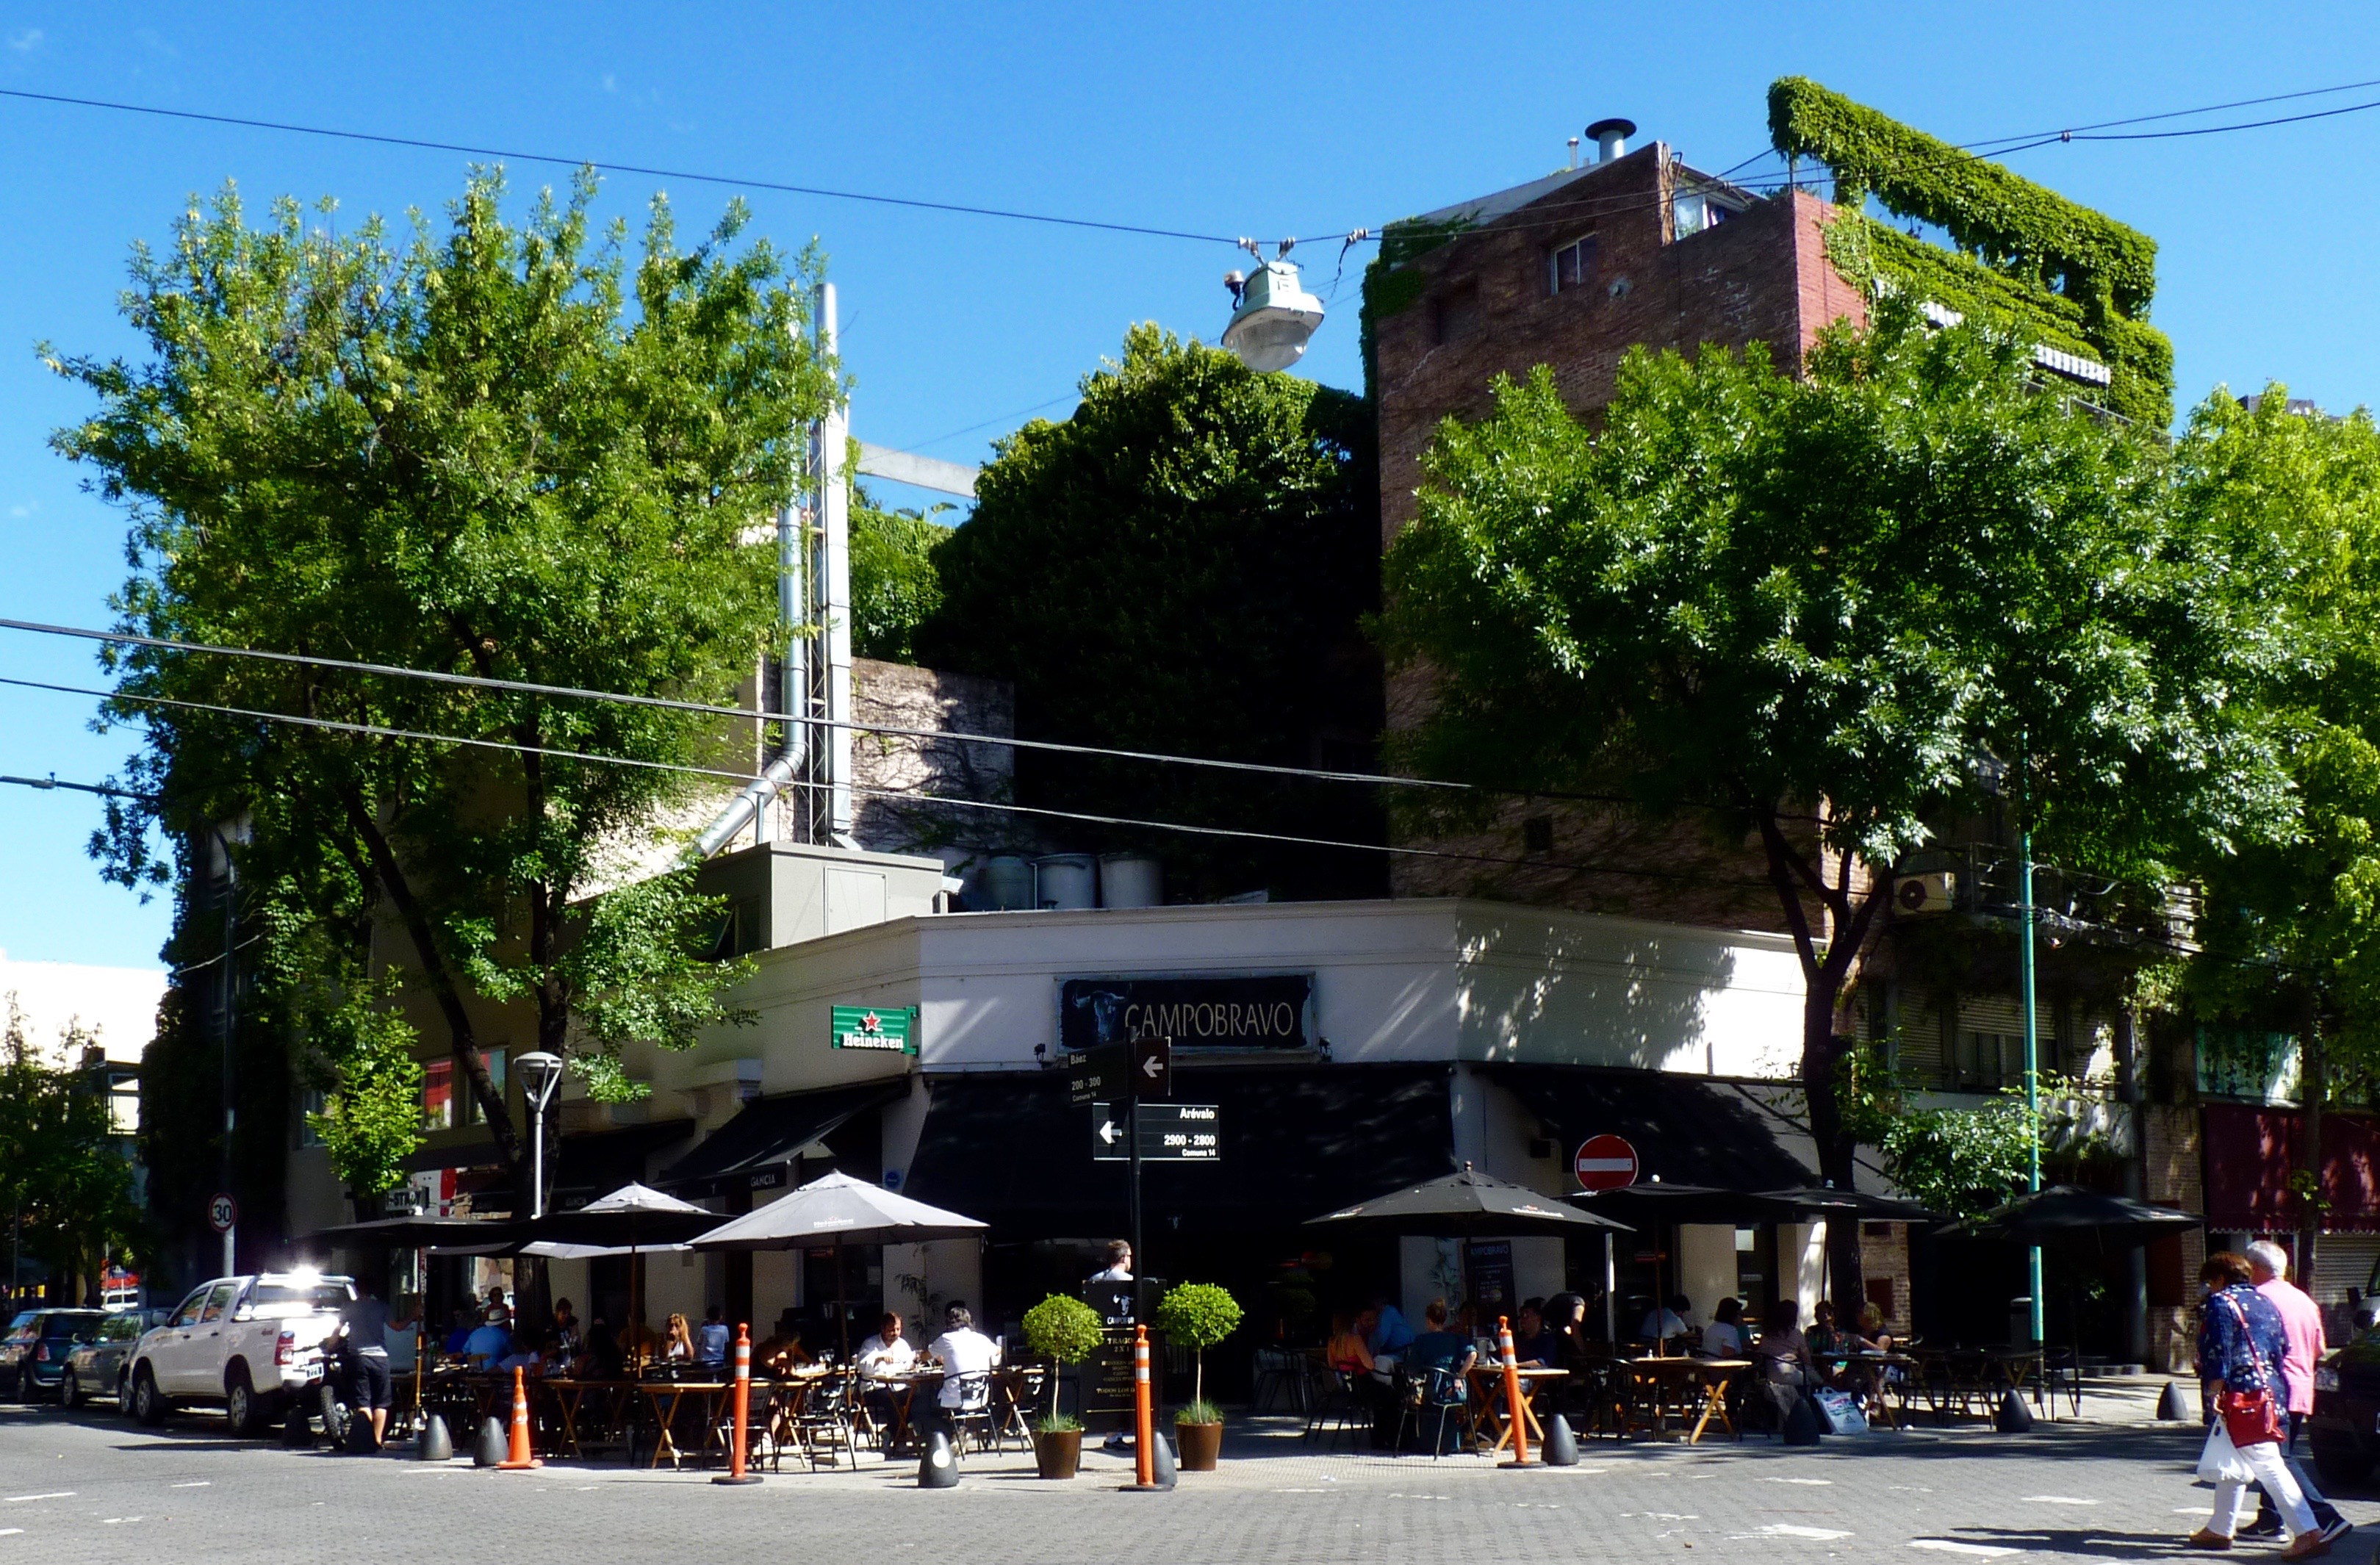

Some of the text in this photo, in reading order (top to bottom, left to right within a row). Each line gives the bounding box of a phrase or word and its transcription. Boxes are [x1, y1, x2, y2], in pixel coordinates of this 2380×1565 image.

[1124, 1002, 1293, 1037] CAMPOBRAVO
[843, 1032, 904, 1049] Heineken
[1071, 1079, 1084, 1090] 200
[1088, 1076, 1101, 1087] 300
[1179, 1107, 1215, 1119] Arévalo
[1164, 1134, 1187, 1145] 2900
[1193, 1134, 1216, 1145] 2800
[1182, 1148, 1216, 1156] Comuna 14
[750, 1173, 776, 1188] GANCIA
[214, 1204, 232, 1223] 30
